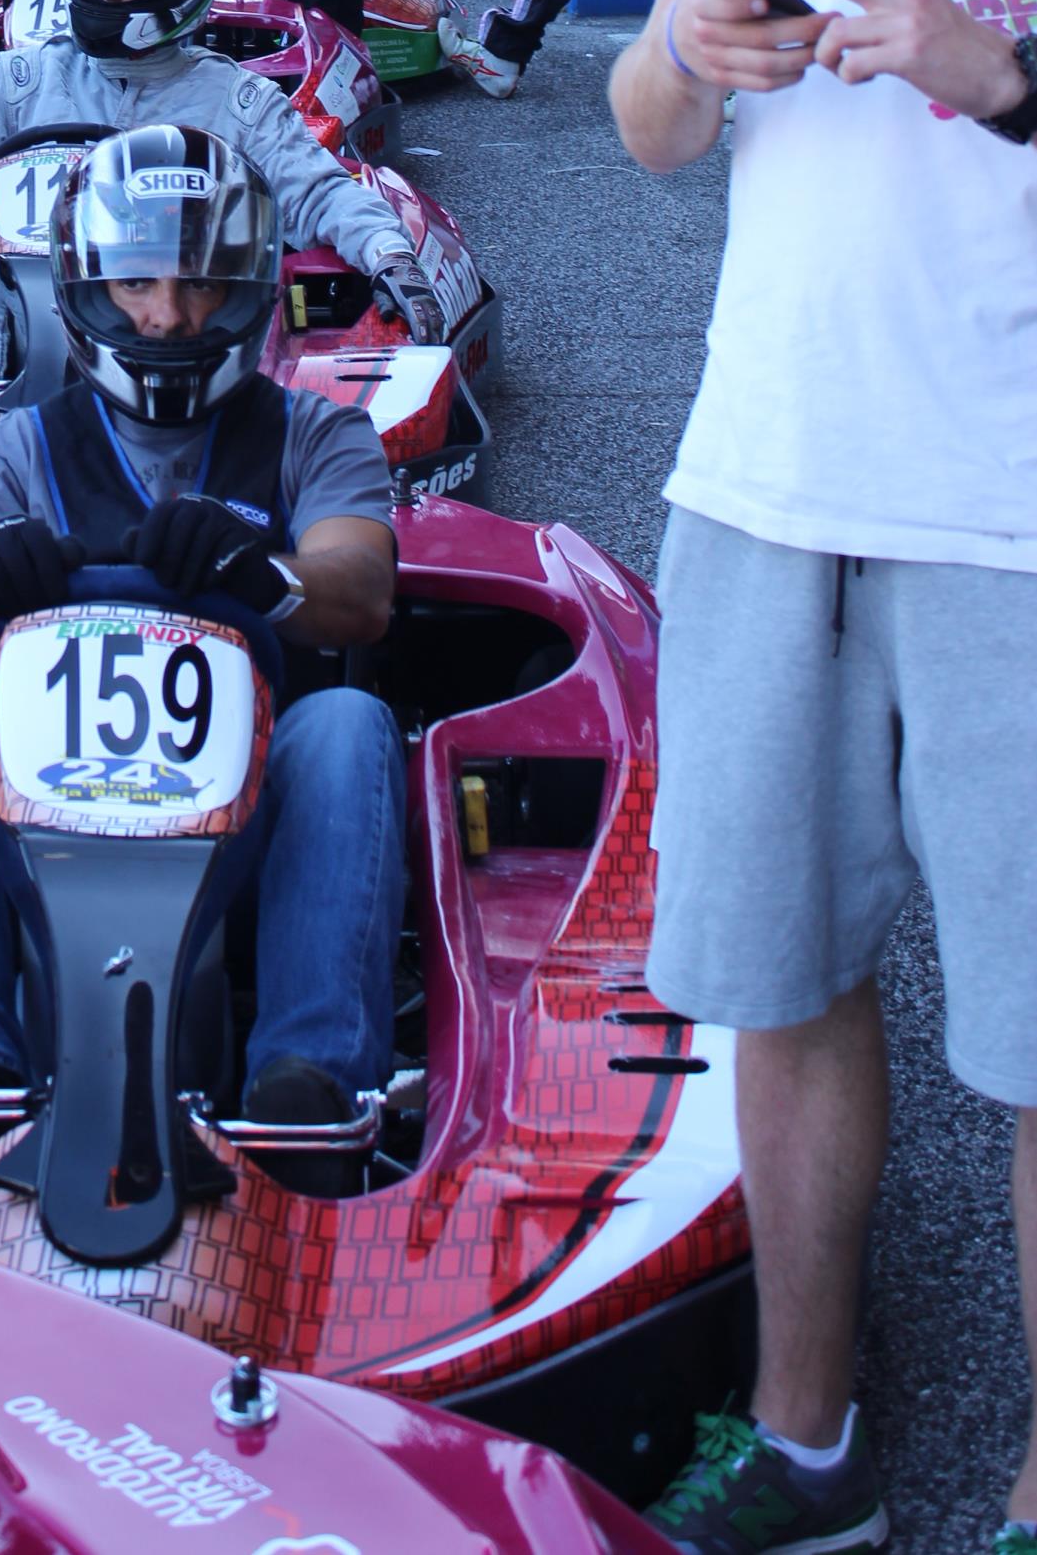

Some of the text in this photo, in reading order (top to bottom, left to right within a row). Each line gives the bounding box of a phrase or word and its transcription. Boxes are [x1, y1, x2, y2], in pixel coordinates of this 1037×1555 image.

[21, 152, 82, 167] EUROIN
[139, 173, 205, 192] SHOEI
[15, 163, 68, 225] 11
[56, 619, 207, 646] EUROINDY
[47, 634, 214, 764] 159
[60, 760, 159, 788] 24
[3, 1394, 217, 1527] AUTÓDROMO
[108, 1422, 248, 1521] VIRTUAL
[192, 1447, 274, 1502] LISBOA
